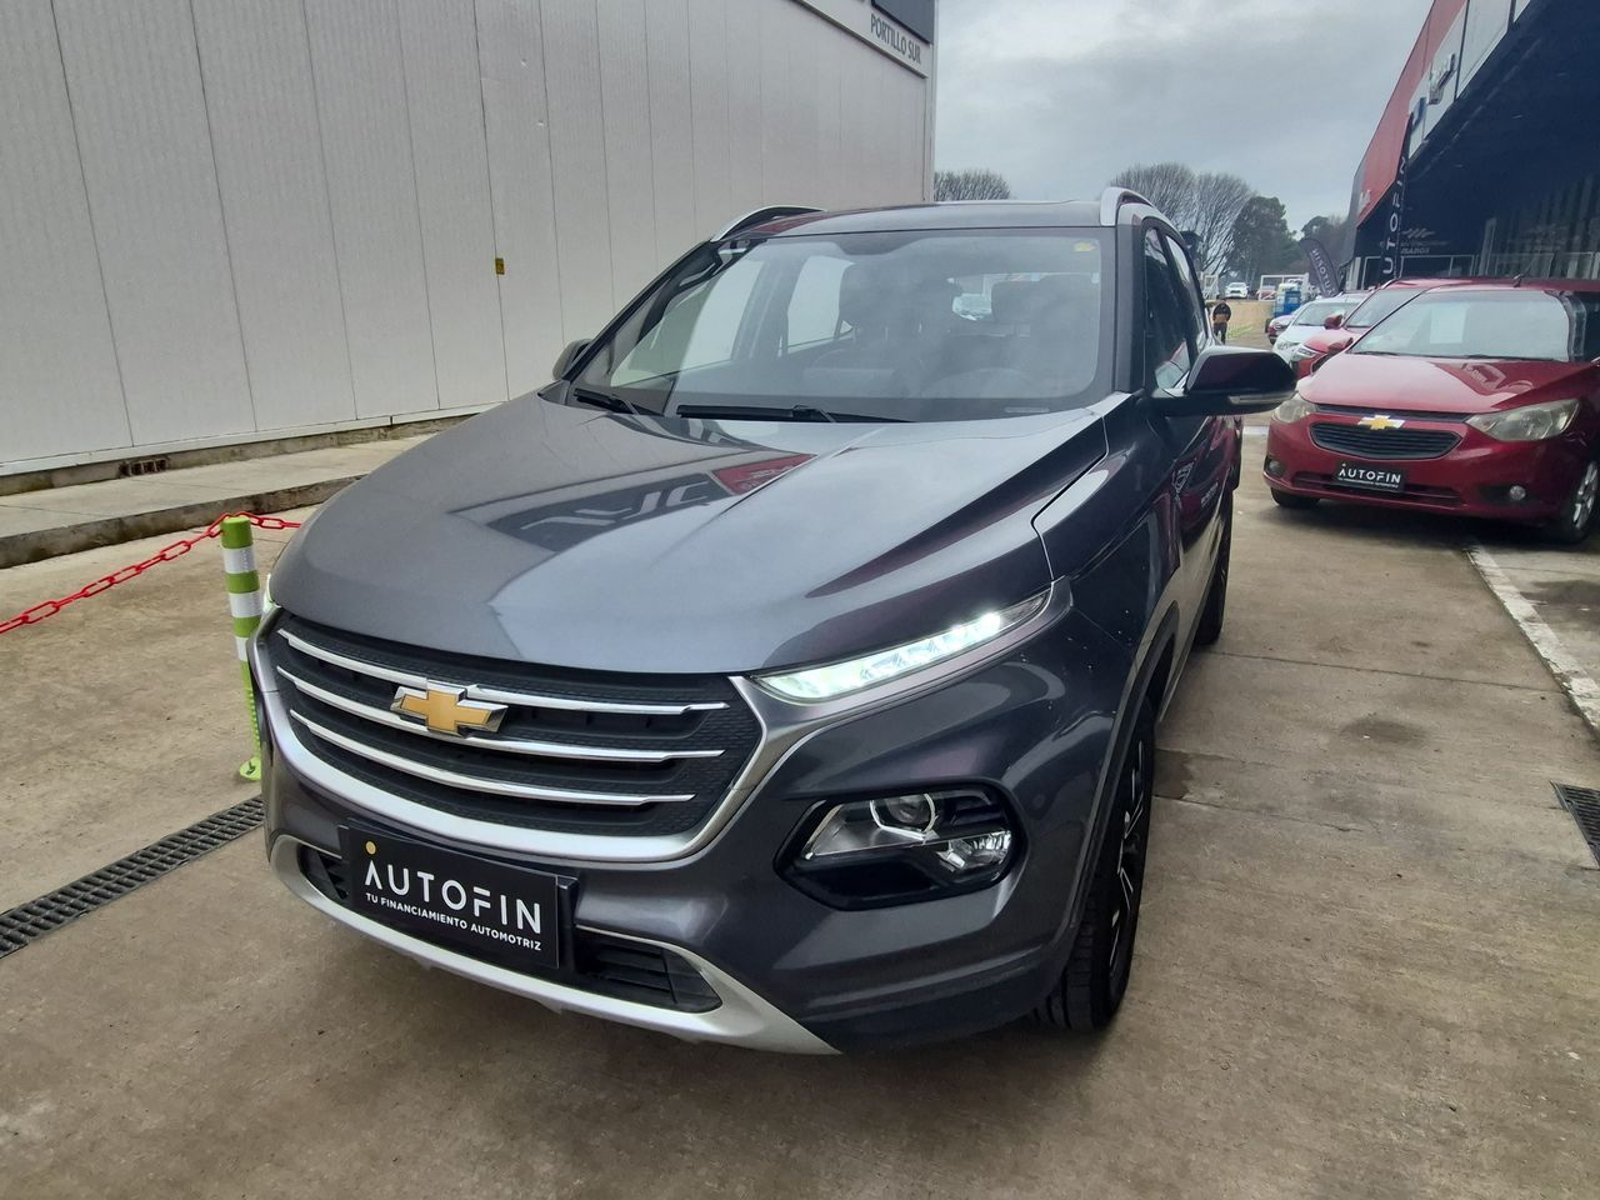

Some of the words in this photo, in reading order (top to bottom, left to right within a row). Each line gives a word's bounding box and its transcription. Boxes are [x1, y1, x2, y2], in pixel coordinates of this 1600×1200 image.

[871, 13, 906, 56] PORTILLO
[908, 40, 921, 64] SUR
[1382, 155, 1405, 275] UTOFIN
[1339, 468, 1401, 484] AUTOFIN
[364, 860, 541, 934] AUTOFIN
[366, 892, 379, 904] TU
[381, 896, 468, 930] FINANCIAMIENTO
[470, 923, 542, 951] AUTOMOTRIZ
